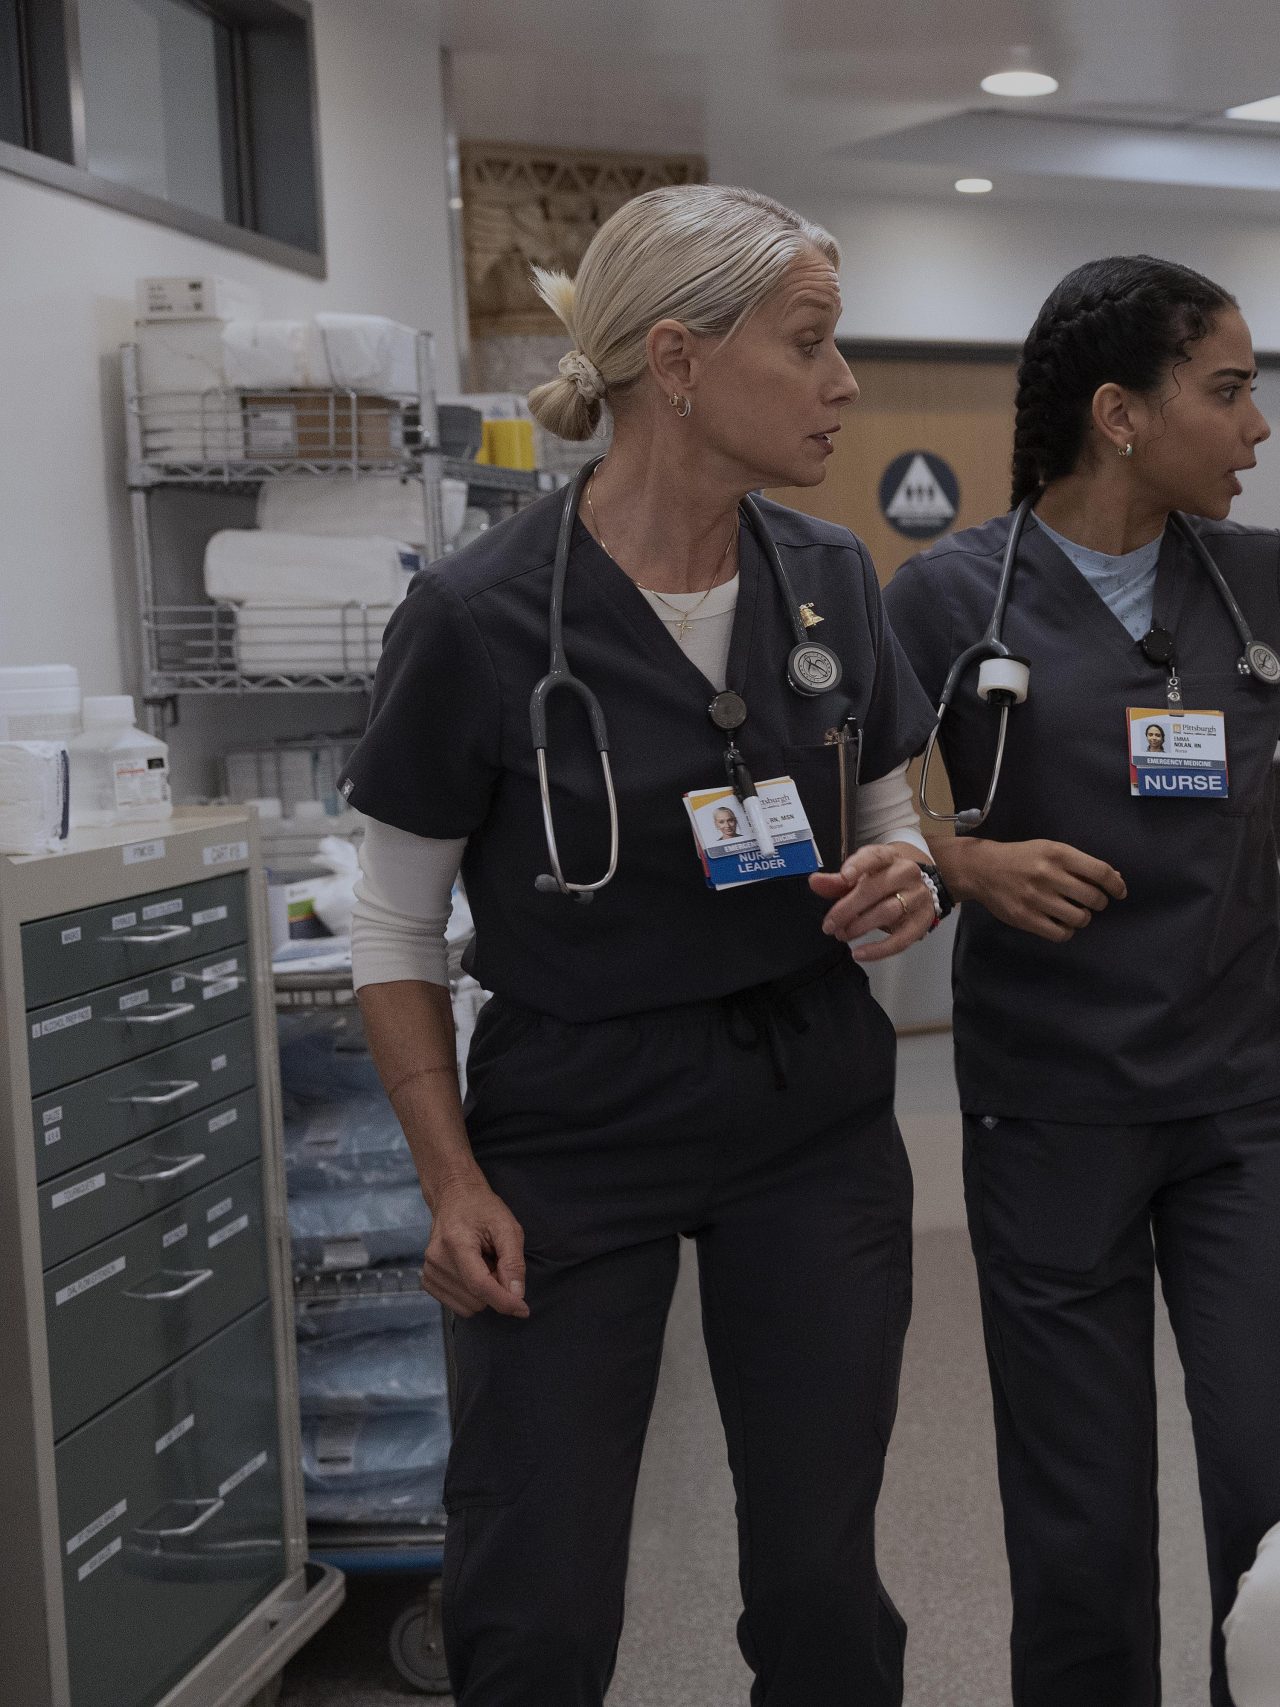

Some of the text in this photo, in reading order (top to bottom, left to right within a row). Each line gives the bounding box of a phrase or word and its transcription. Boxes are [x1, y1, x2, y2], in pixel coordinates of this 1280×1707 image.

[1182, 724, 1217, 734] Pittsburgh
[1146, 757, 1212, 768] EMERGENCY MEDICINE
[1144, 775, 1223, 791] NURSE
[723, 840, 760, 853] EMERGEN
[739, 848, 780, 862] NURE
[738, 859, 787, 873] LEADER
